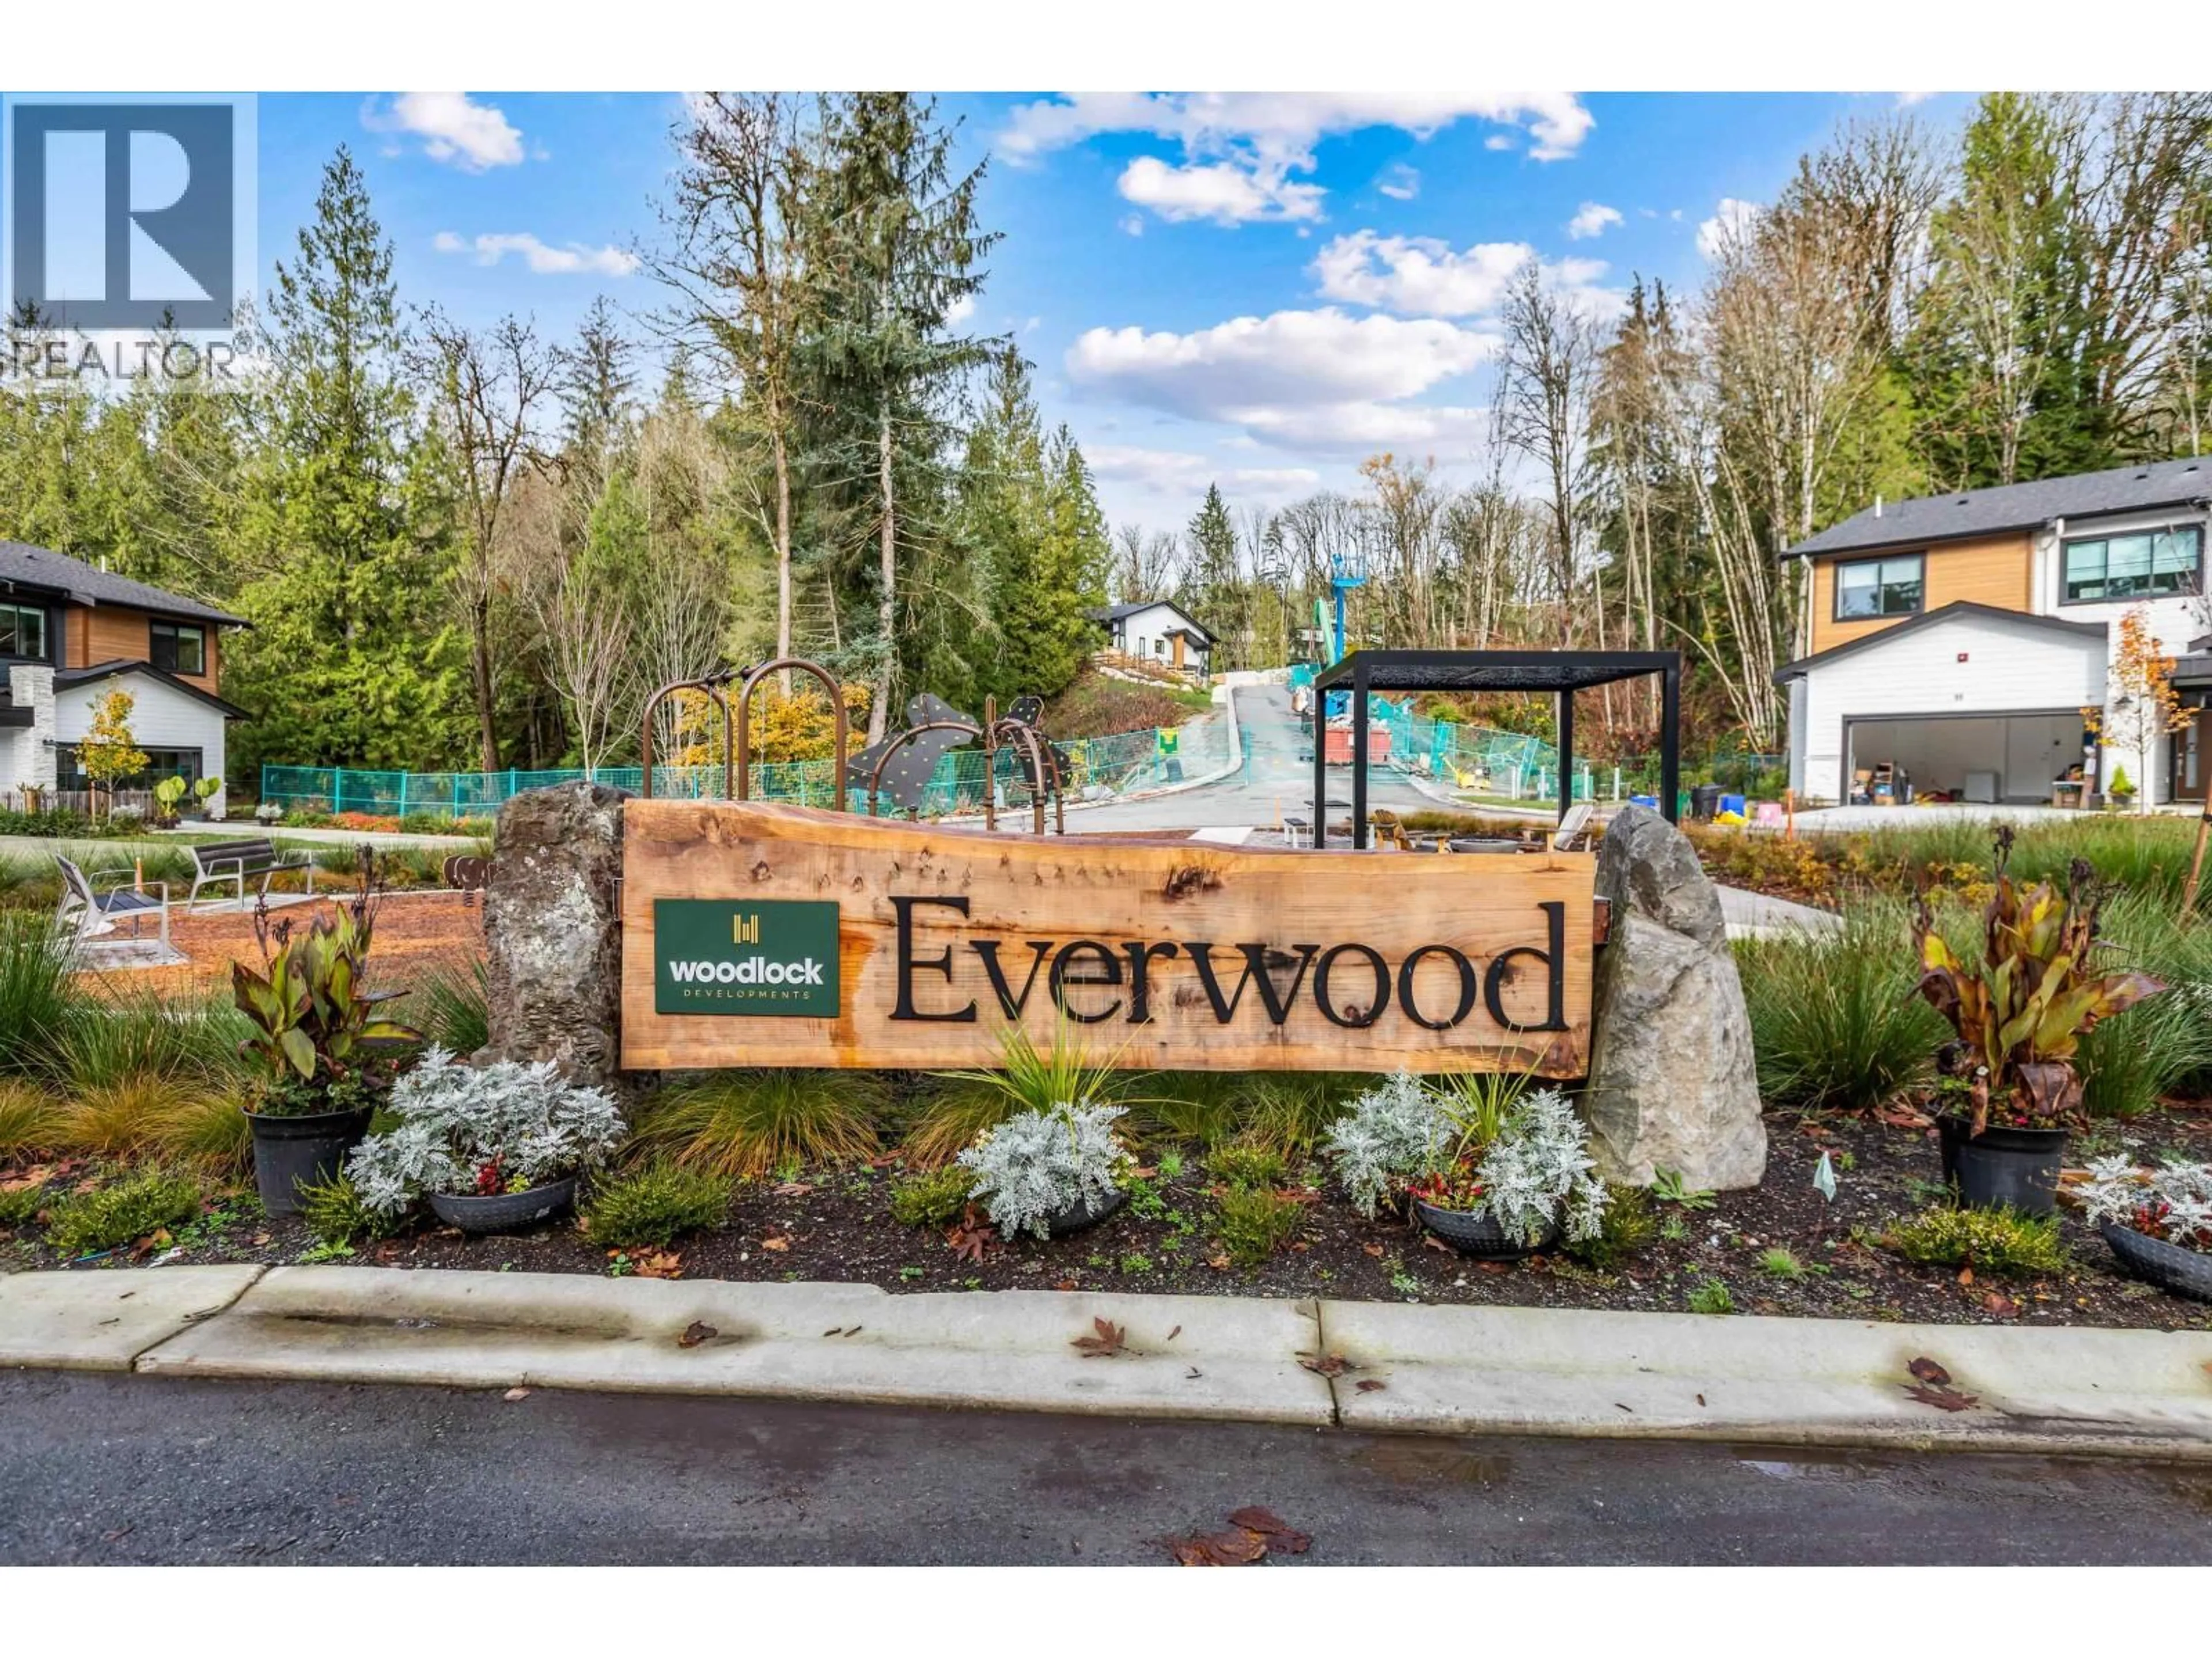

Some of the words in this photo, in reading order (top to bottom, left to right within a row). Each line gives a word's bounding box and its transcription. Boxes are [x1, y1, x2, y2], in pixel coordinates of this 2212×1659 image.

[669, 956, 824, 985] woodlock
[887, 895, 1569, 1033] Everwood
[684, 988, 810, 999] DEVELOPMENTS
